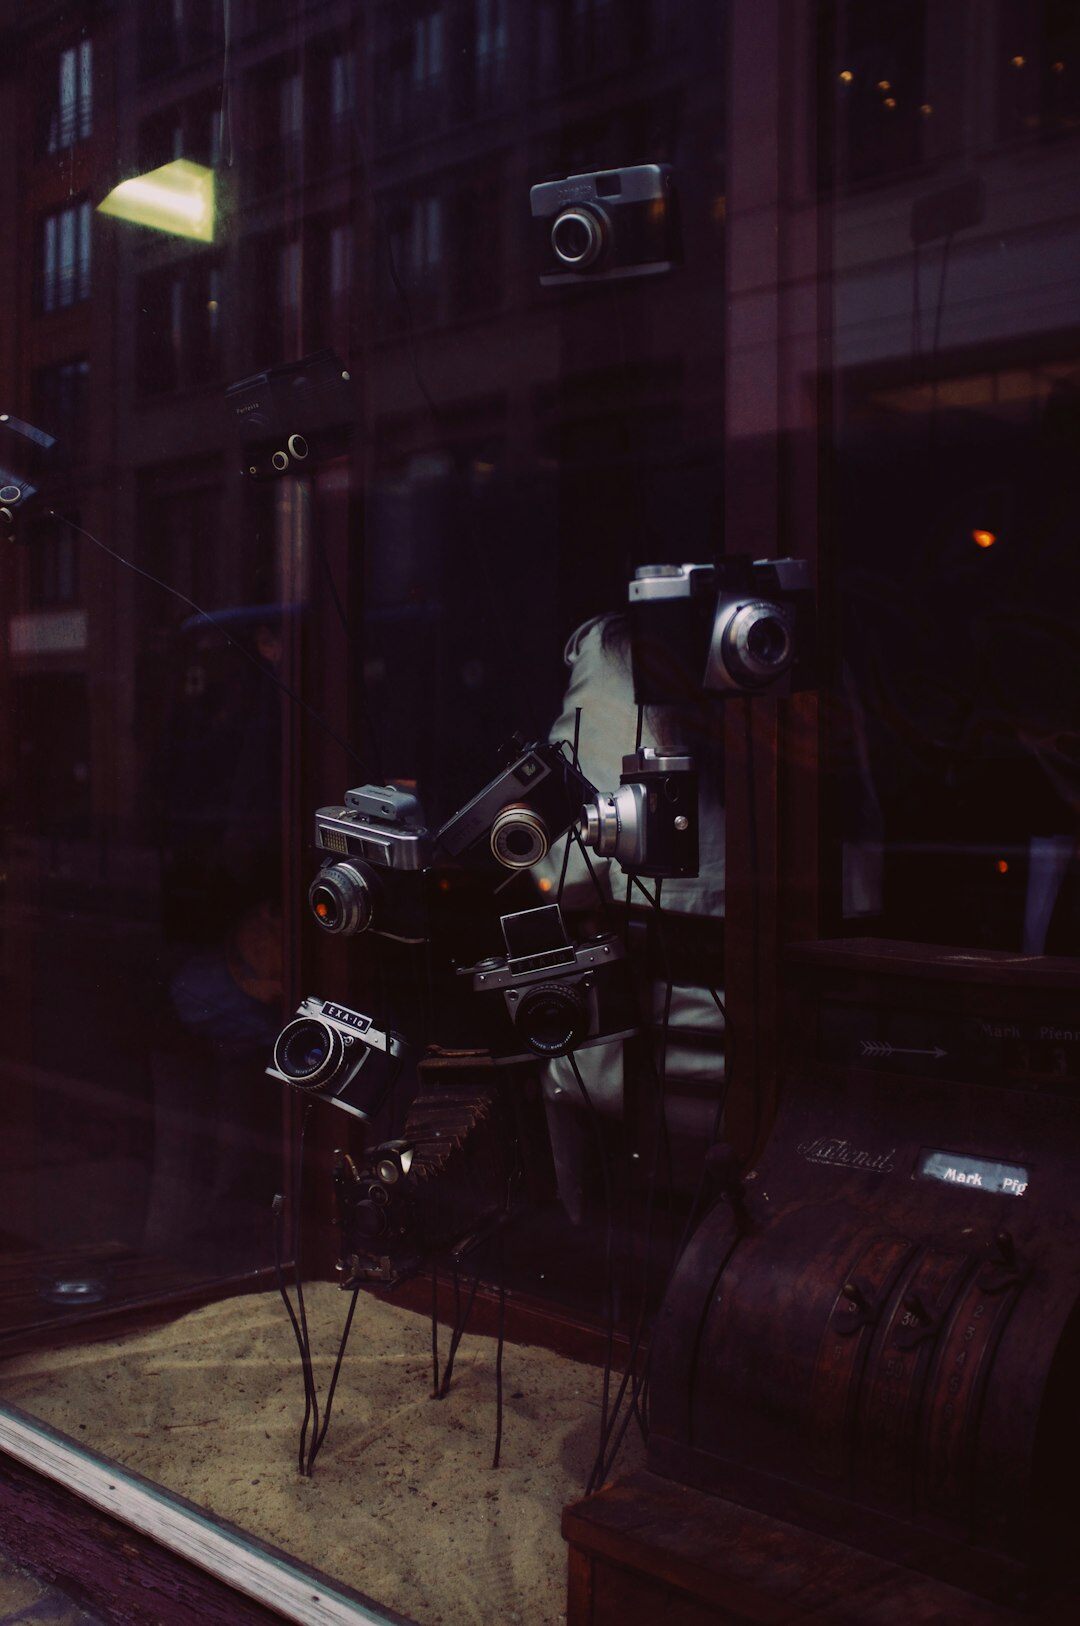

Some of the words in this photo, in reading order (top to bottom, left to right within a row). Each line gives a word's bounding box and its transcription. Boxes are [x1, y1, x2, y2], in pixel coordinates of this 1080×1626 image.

[980, 1023, 1021, 1040] Mark
[797, 1138, 895, 1172] National
[944, 1168, 982, 1187] Mark
[1003, 1178, 1028, 1197] Pfg
